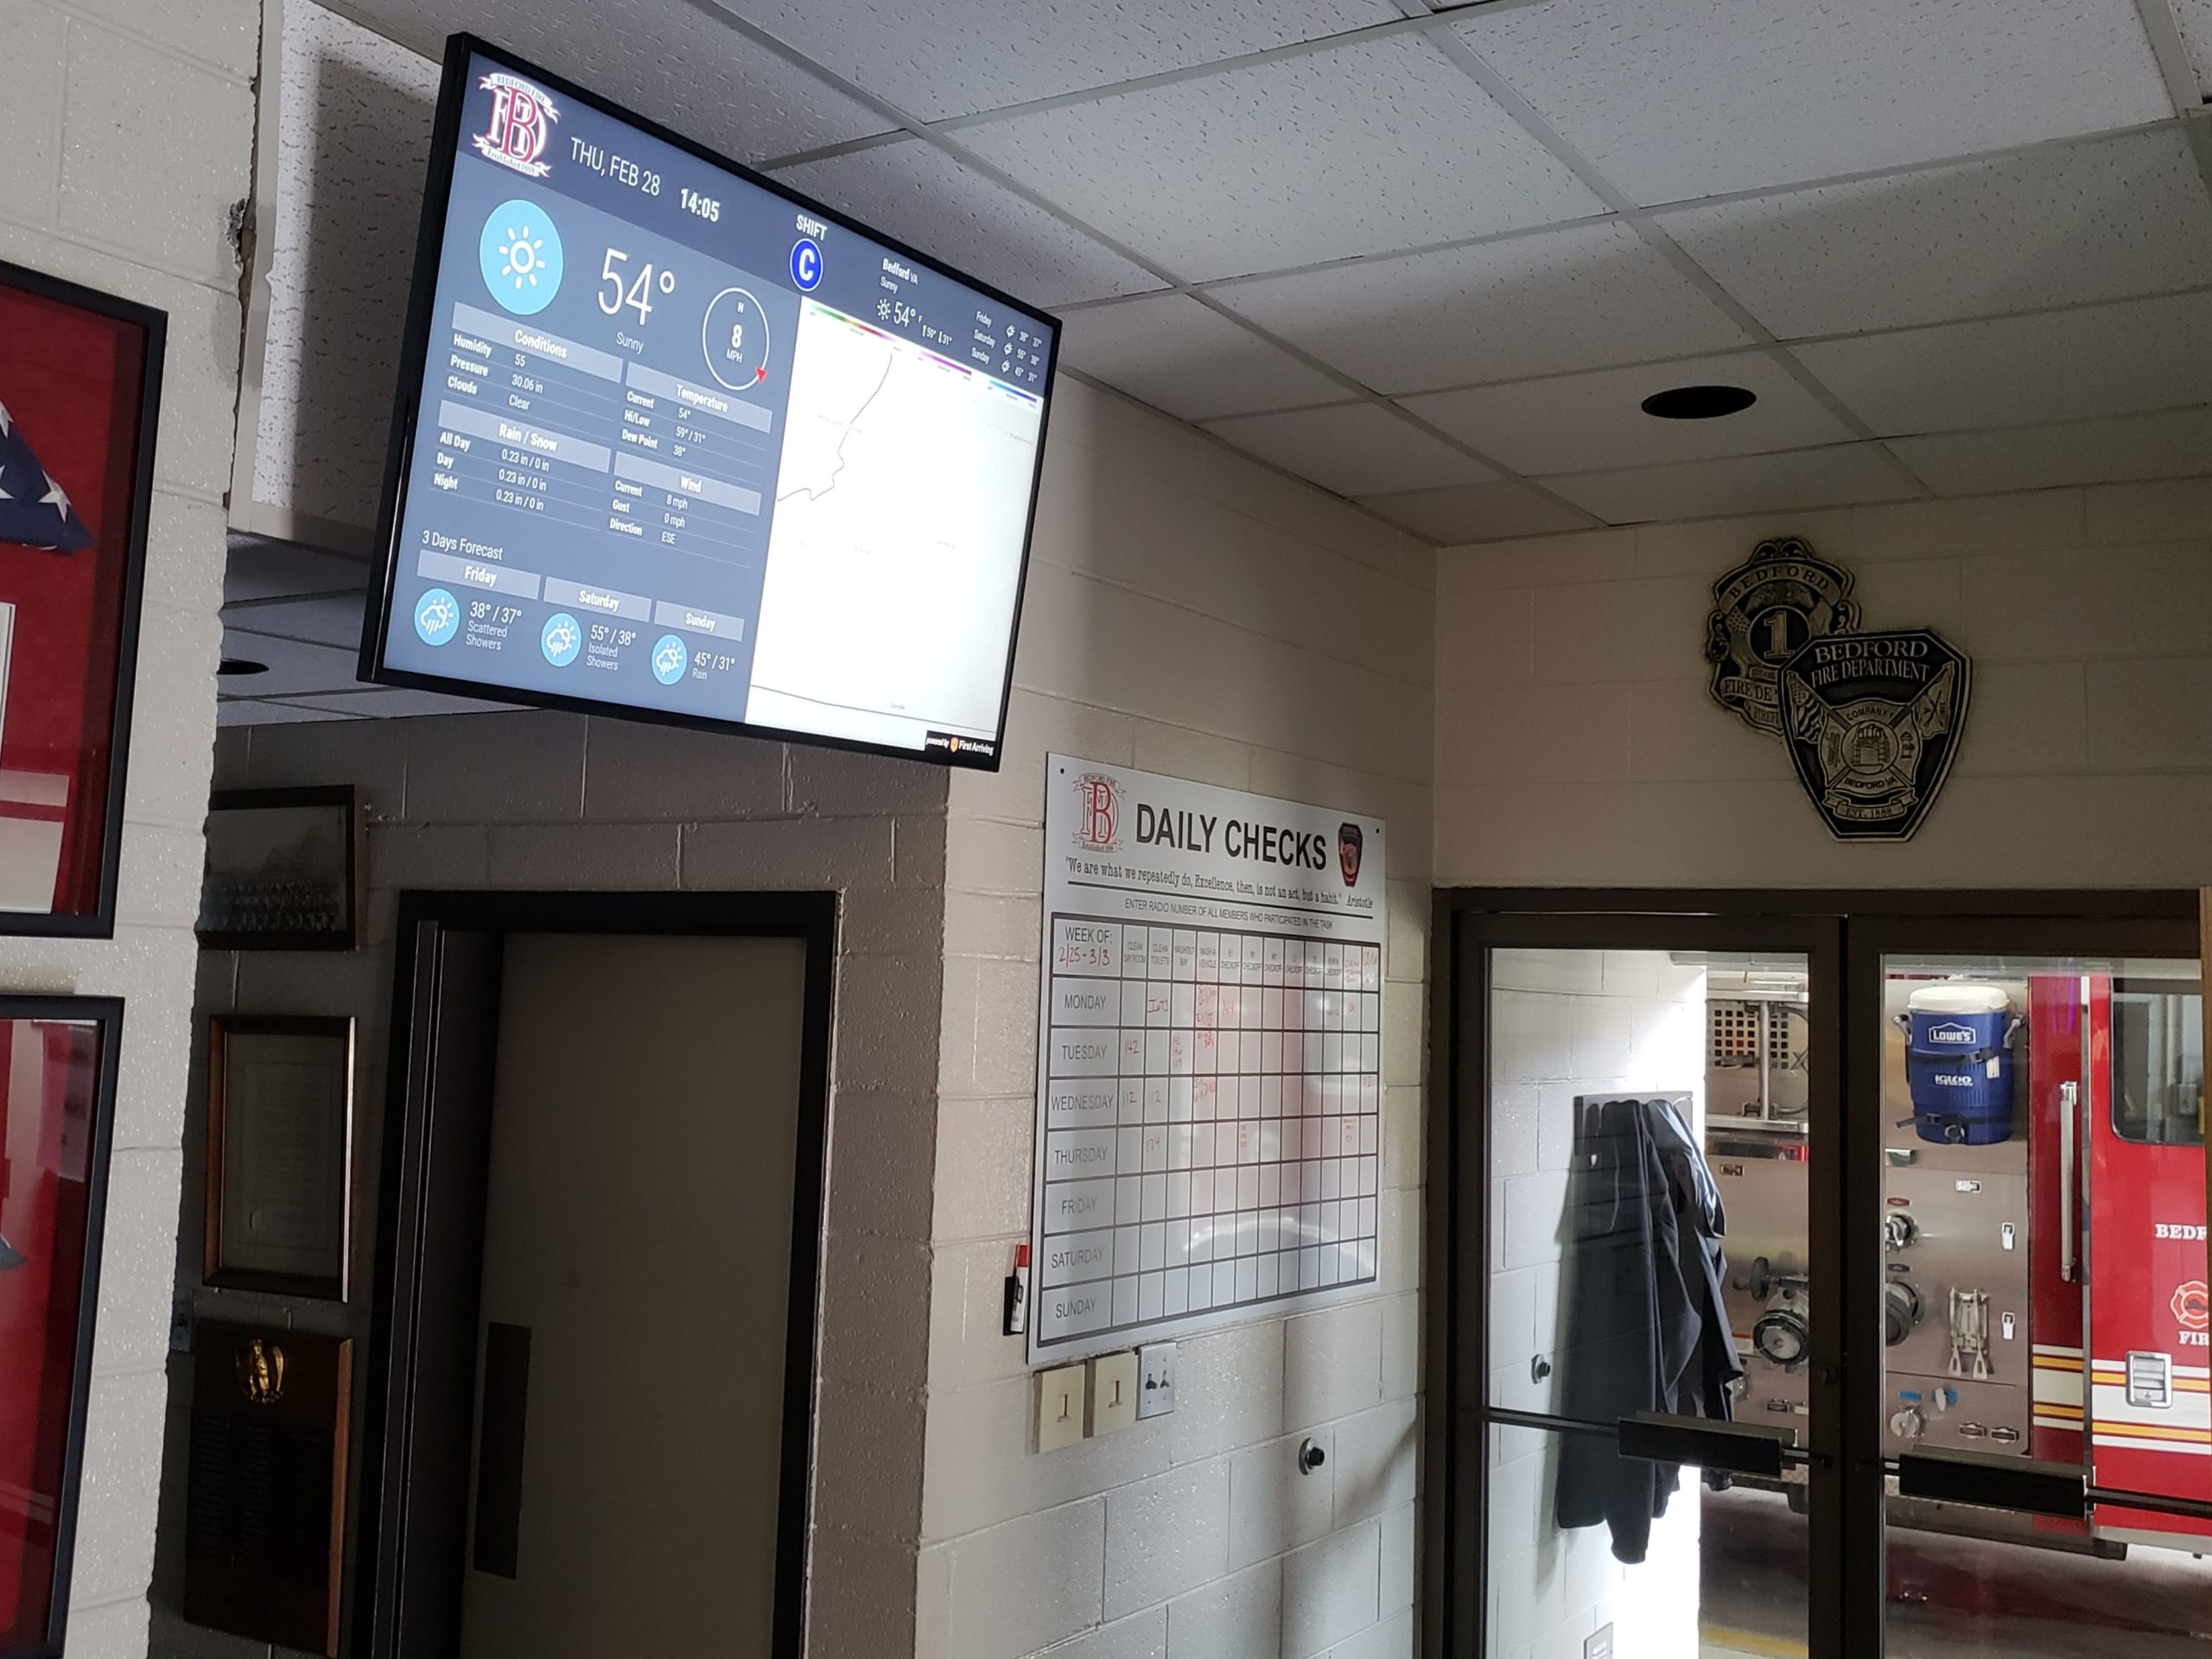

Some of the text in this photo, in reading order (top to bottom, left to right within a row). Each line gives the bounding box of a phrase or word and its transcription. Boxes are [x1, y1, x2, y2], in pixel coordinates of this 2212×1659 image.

[570, 137, 660, 196] THU, FEB 28
[680, 188, 720, 222] 14:05
[796, 214, 828, 241] SHIFT
[798, 248, 815, 281] C
[882, 258, 918, 285] Bedford VA
[880, 276, 899, 295] Sunny
[738, 302, 744, 314] N
[976, 311, 993, 328] Friday
[514, 329, 568, 359] Conditions
[616, 332, 644, 355] Sunny
[732, 324, 743, 348] 8
[974, 329, 996, 349] Saturday
[454, 334, 525, 367] Humidity 55
[726, 348, 743, 364] MPH
[970, 347, 990, 365] Sunday
[450, 354, 543, 394] Pressure 30.06 in
[448, 375, 531, 410] Clouds Clear
[626, 391, 654, 410] Current
[677, 384, 728, 413] Temperature
[624, 410, 651, 428] Hi/Low
[499, 423, 558, 452] Rain Snow
[621, 429, 638, 442] Dew
[639, 435, 658, 450] Point
[439, 431, 550, 473] All Day 0.23 in in
[436, 452, 547, 492] Day 0.23 in in
[434, 473, 544, 512] Night 0.23 in in
[615, 480, 688, 511] Current 8 mph
[680, 476, 702, 493] Wind
[613, 499, 685, 529] Gust 0 mph
[609, 518, 677, 544] Direction ESE
[422, 530, 504, 561] 3 Days Forecast
[464, 565, 497, 587] Friday
[1728, 565, 1829, 599] BEDFORD
[578, 590, 620, 612] Saturday
[467, 620, 508, 638] Scattered
[685, 613, 716, 632] Sunday
[466, 634, 502, 651] Showers
[1764, 610, 1795, 659] 1
[588, 643, 619, 658] Isolated
[1815, 640, 1928, 664] BEDFORD
[587, 656, 619, 671] Showers
[692, 668, 707, 680] Rain
[1811, 658, 1930, 689] FIRE DEPARTMENT
[1725, 680, 1751, 696] FIRE
[1846, 707, 1888, 721] COMPANY
[958, 740, 994, 757] First Arriving
[1844, 777, 1898, 790] BEDFORD VA
[1846, 807, 1892, 818] EST. 1888
[1136, 803, 1326, 871] DAILY CHECKS
[1084, 863, 1098, 875] are
[1101, 862, 1122, 879] what
[1124, 868, 1136, 880] we
[1138, 871, 1180, 888] repeatedly
[1181, 873, 1192, 889] do,
[1194, 874, 1235, 894] Excellence,
[1236, 880, 1255, 895] then,
[1256, 882, 1263, 895] is
[1264, 886, 1275, 898] not
[1277, 888, 1287, 899] an
[1302, 888, 1313, 902] but
[1314, 893, 1319, 903] a
[1345, 894, 1374, 909] Aristotle
[1125, 898, 1333, 930] ENTER RADIO NUMBER OF ALL MEMBERS WHO PARTICIPATED IN THE TASK
[1065, 926, 1113, 944] WEEK OF:
[1064, 995, 1107, 1010] MONDAY
[1061, 1046, 1107, 1060] TUESDAY
[1051, 1095, 1114, 1111] WEDNESDAY
[1054, 1147, 1108, 1166] THURSDAY
[1061, 1197, 1098, 1216] FRIDAY
[1051, 1247, 1104, 1269] SATURDAY
[1055, 1299, 1097, 1319] SUNDAY
